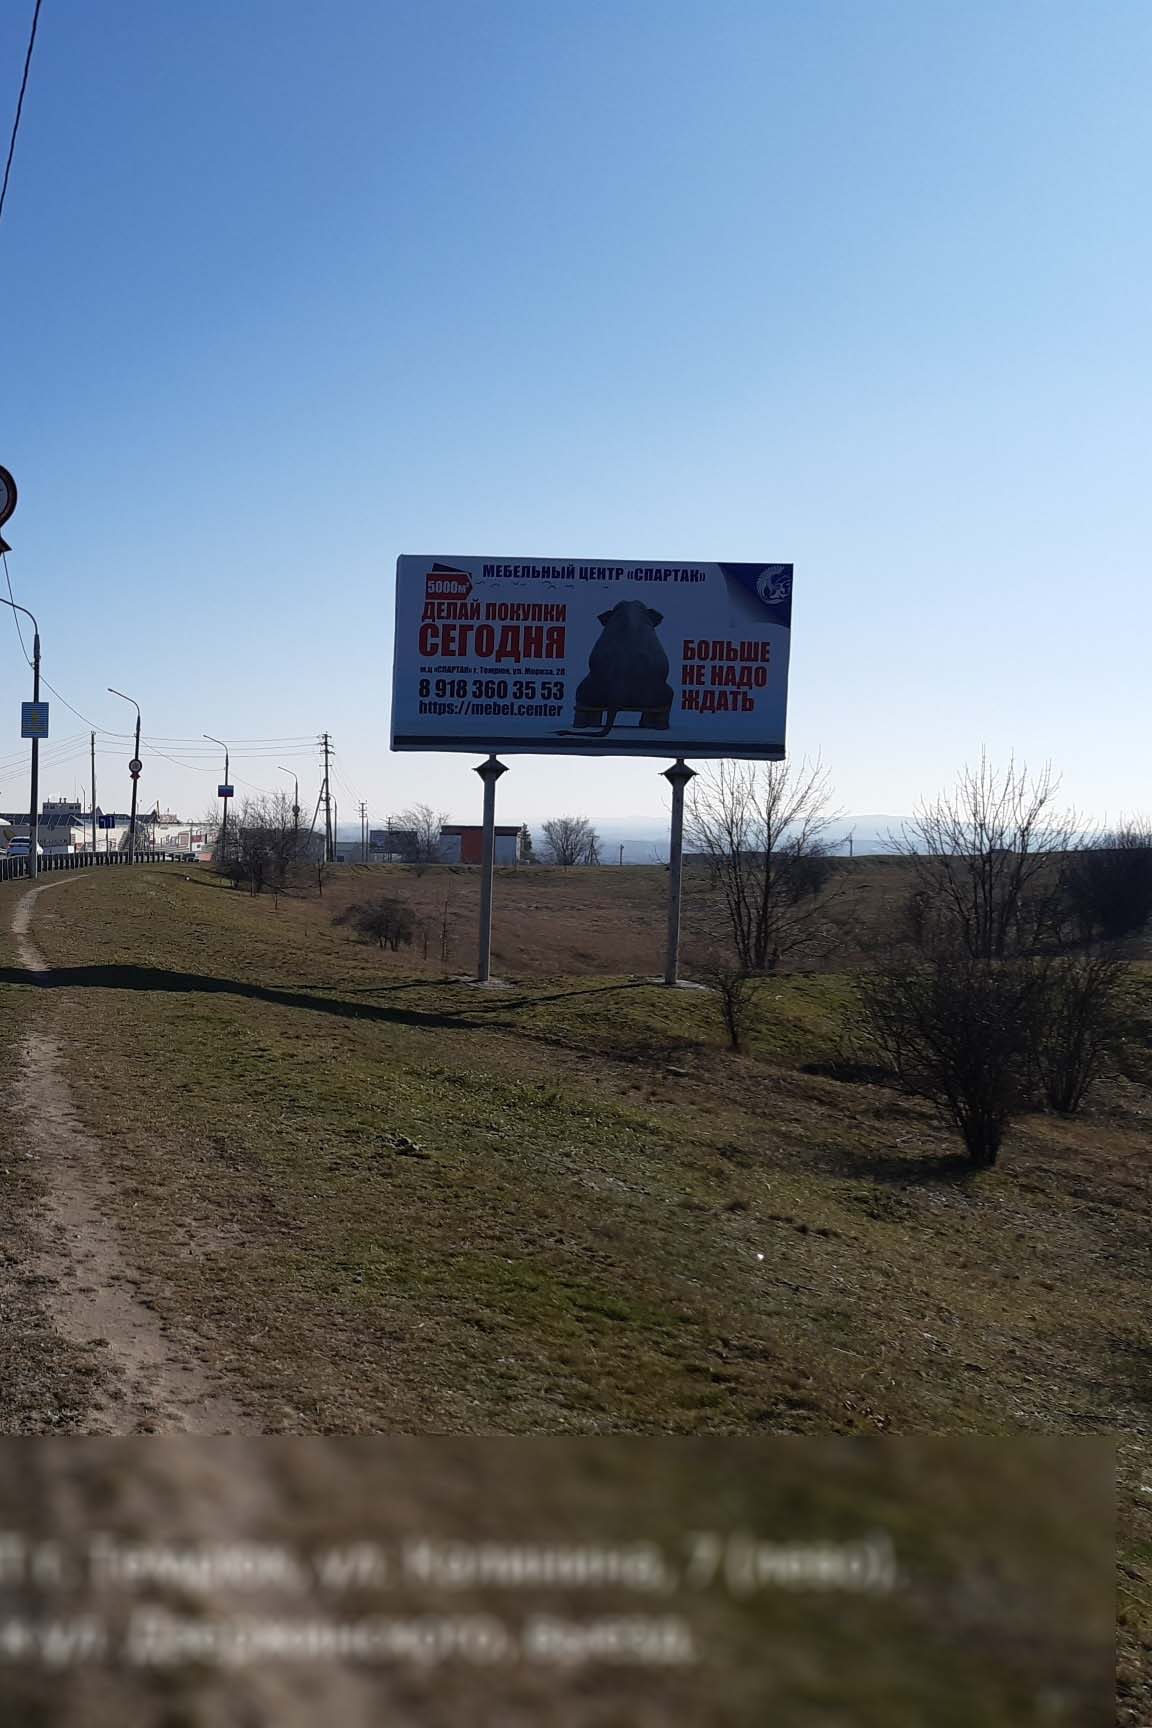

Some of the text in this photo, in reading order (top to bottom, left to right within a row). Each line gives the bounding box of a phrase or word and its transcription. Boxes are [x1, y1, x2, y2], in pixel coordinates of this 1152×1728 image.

[483, 564, 705, 582] МЕБЕЛЬНЫЙ ЦЕНТР «СПАРТАН»
[422, 599, 566, 622] ДЕЛАЙ ПОКУПКИ
[419, 623, 566, 663] СЕГОДНЯ
[683, 639, 770, 662] БОЛЬШЕ
[681, 665, 767, 689] НЕ НАДО
[419, 678, 565, 700] 8 918 360 35 53
[419, 700, 563, 717] https://mebel.center
[681, 690, 754, 714] ЖДАТЬ
